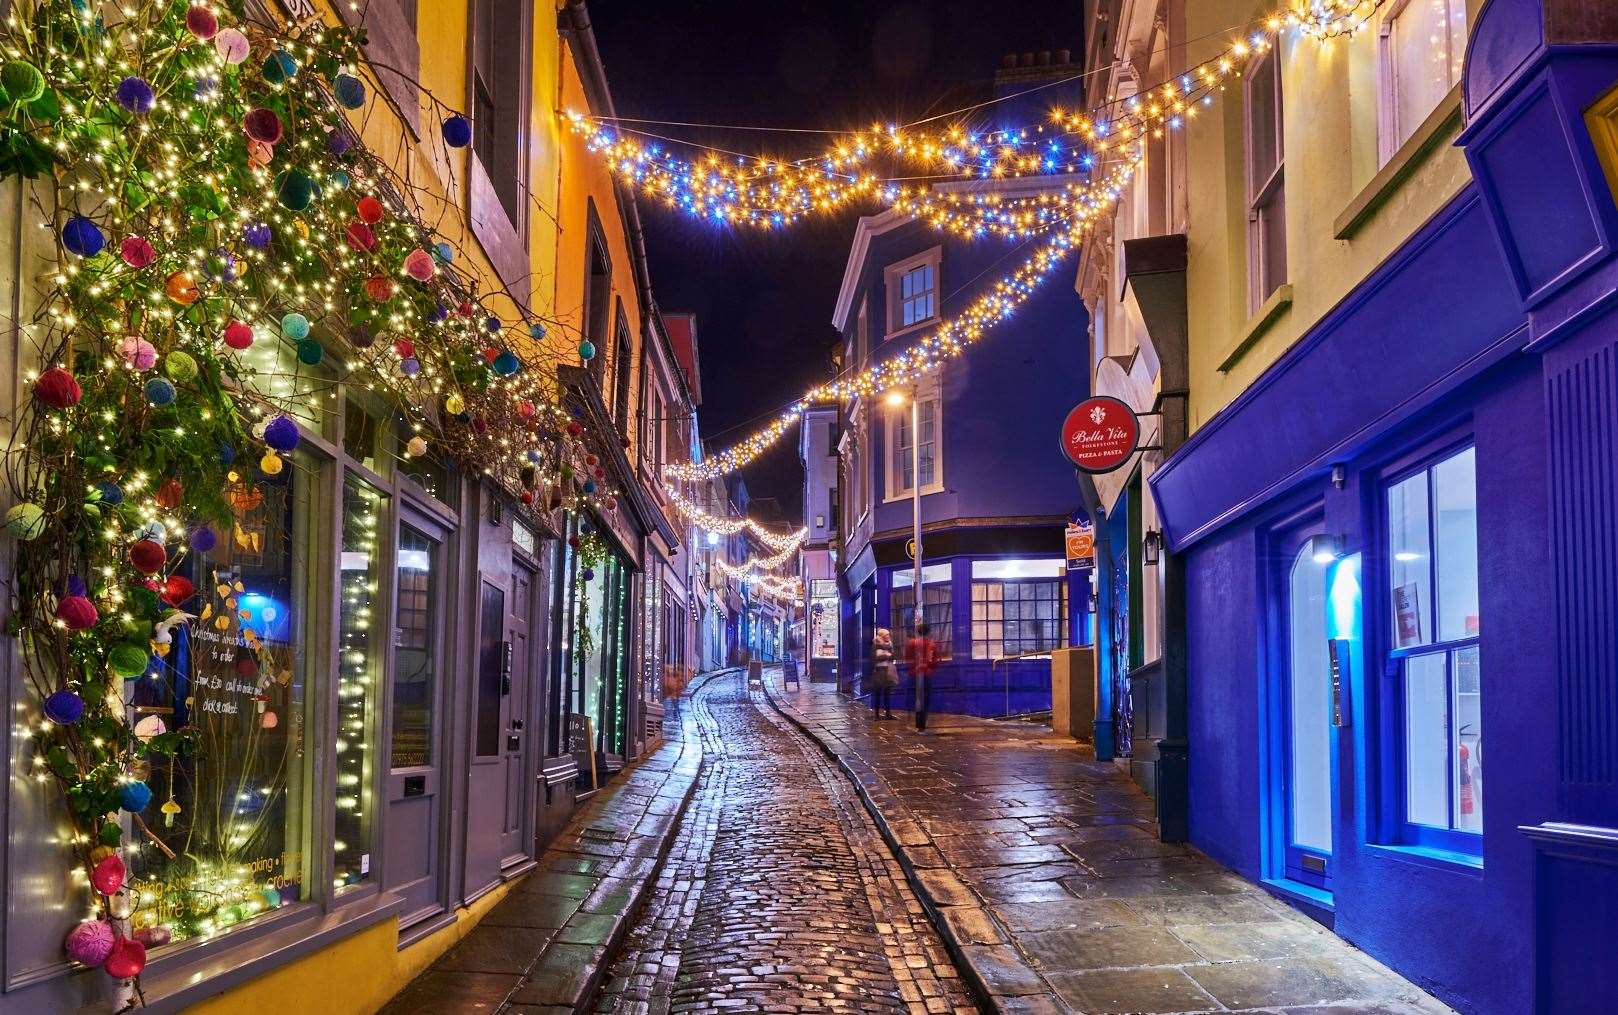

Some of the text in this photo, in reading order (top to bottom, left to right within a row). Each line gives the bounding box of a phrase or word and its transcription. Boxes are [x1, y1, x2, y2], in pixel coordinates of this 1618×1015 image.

[1072, 427, 1127, 443] Bella Vita
[1103, 449, 1123, 457] PASTA
[212, 645, 217, 659] to
